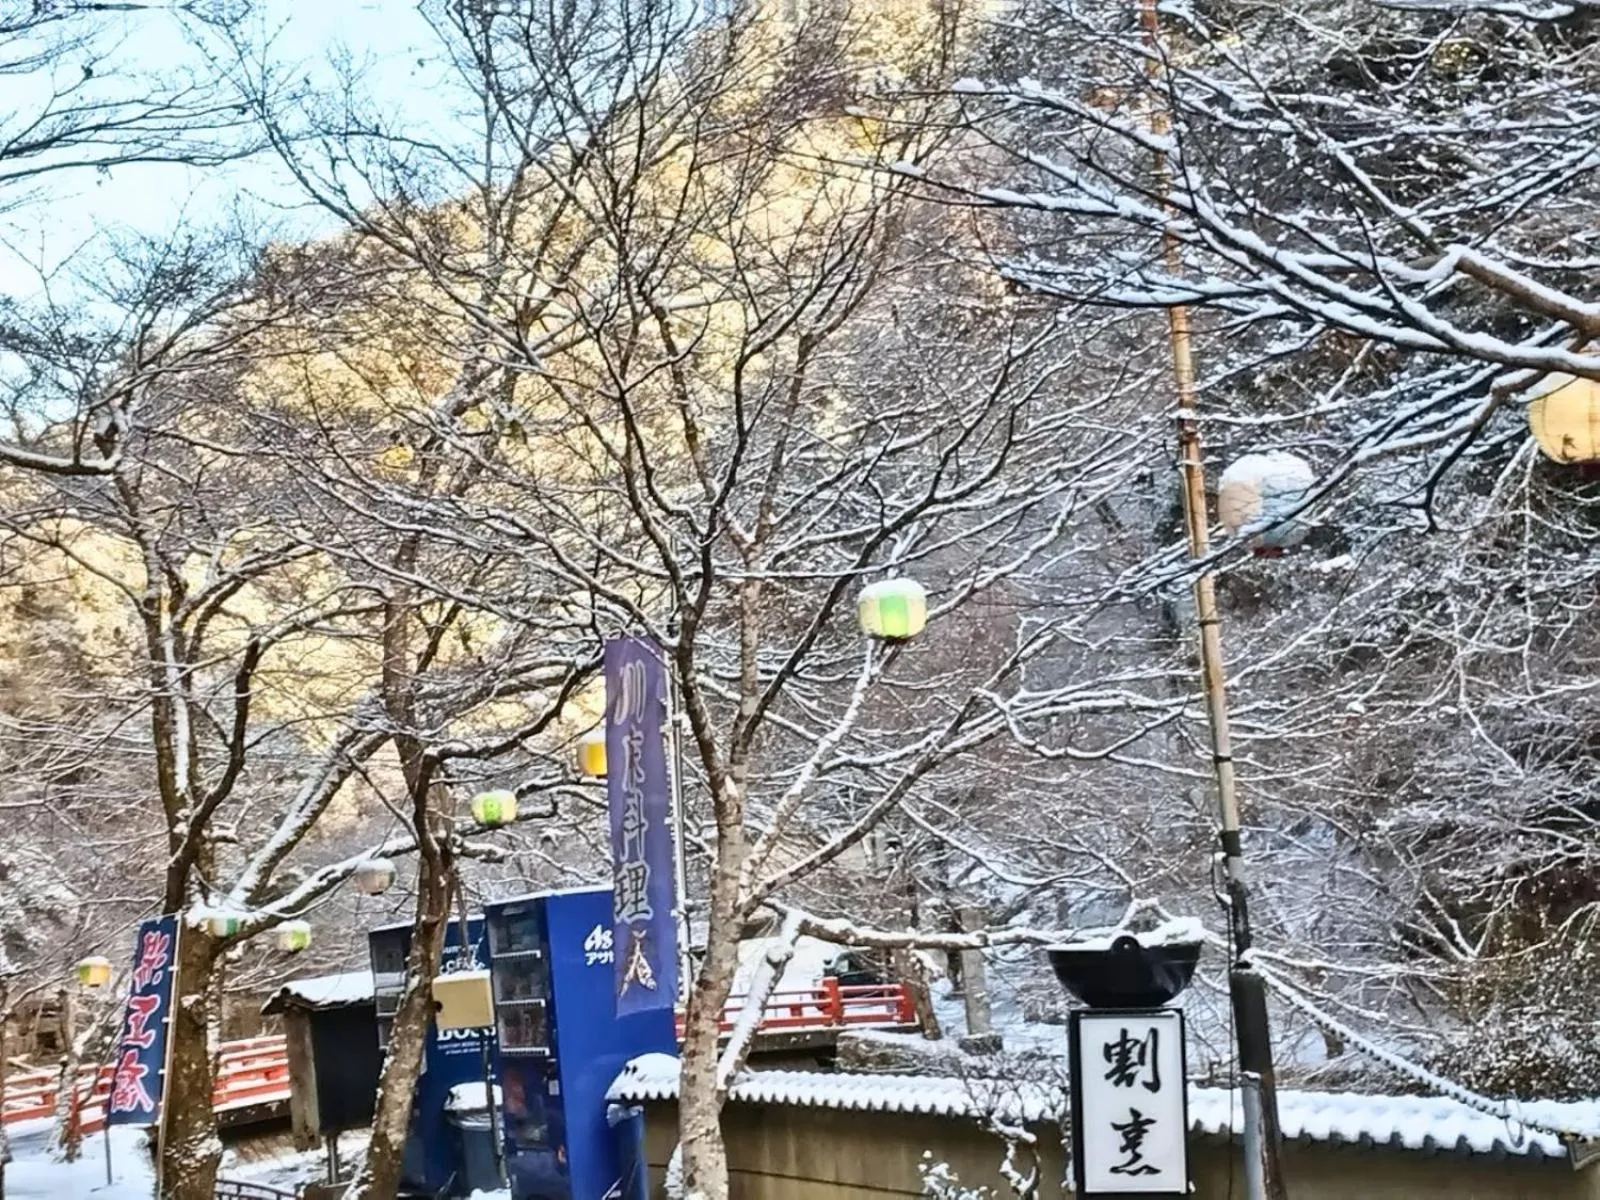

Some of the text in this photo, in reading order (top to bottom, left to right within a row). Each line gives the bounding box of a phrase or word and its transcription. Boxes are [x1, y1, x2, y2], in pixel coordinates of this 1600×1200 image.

[614, 659, 653, 925] 川床料理
[1103, 1027, 1162, 1176] 割烹
